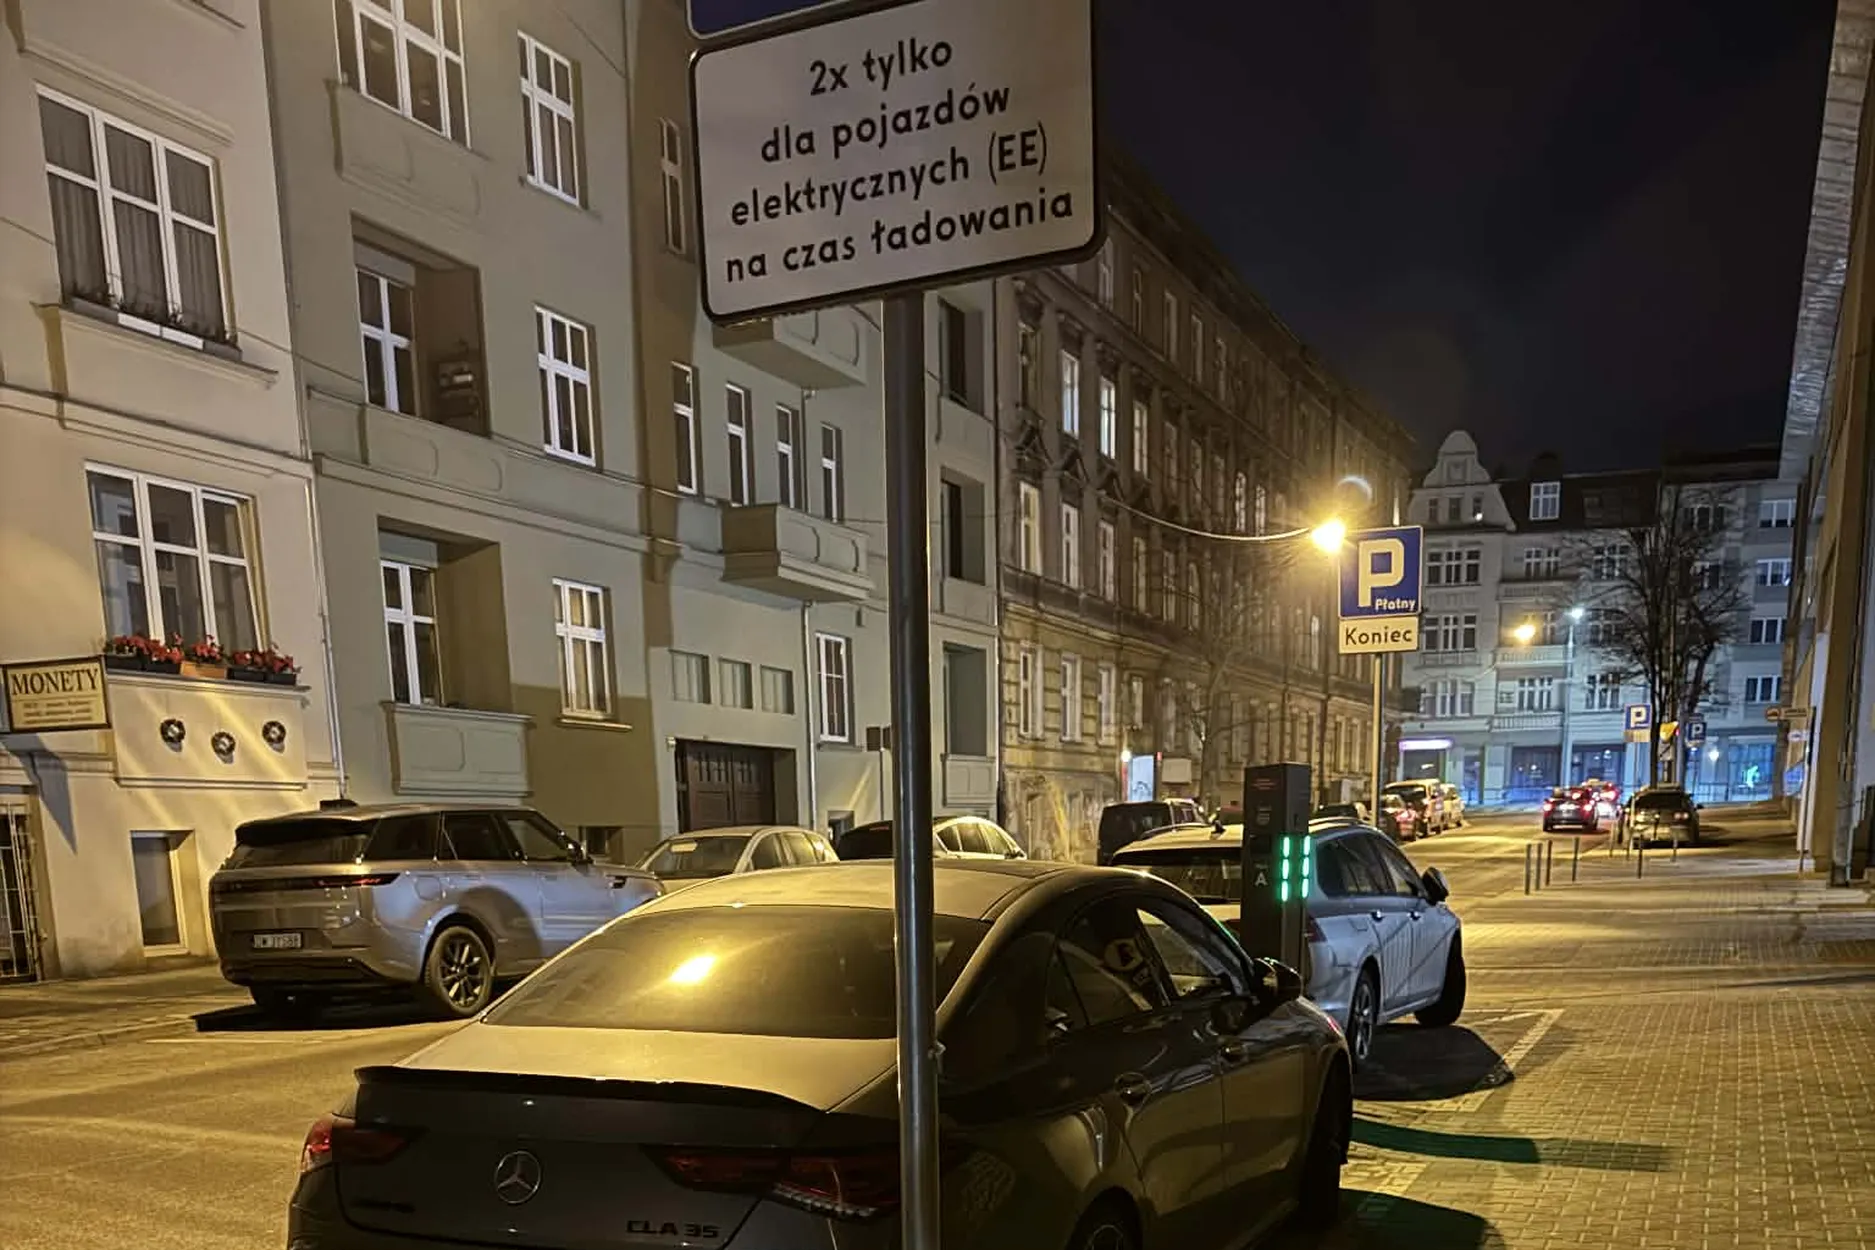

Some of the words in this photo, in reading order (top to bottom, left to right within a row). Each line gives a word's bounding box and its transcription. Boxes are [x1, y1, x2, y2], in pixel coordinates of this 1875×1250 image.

[809, 60, 848, 95] 2x
[862, 38, 952, 90] tylko
[761, 125, 815, 163] dla
[832, 83, 1010, 158] pojazdów
[730, 147, 969, 226] elektrycznych
[988, 121, 1047, 185] (EE)
[726, 252, 767, 283] na
[783, 236, 856, 271] czas
[870, 187, 1073, 254] ładowania
[1358, 538, 1404, 607] P
[1345, 626, 1412, 645] Koniec
[12, 668, 98, 695] MONETY
[1630, 707, 1647, 728] P
[1692, 725, 1703, 738] P
[626, 1220, 677, 1235] CLA
[683, 1221, 721, 1238] 35
